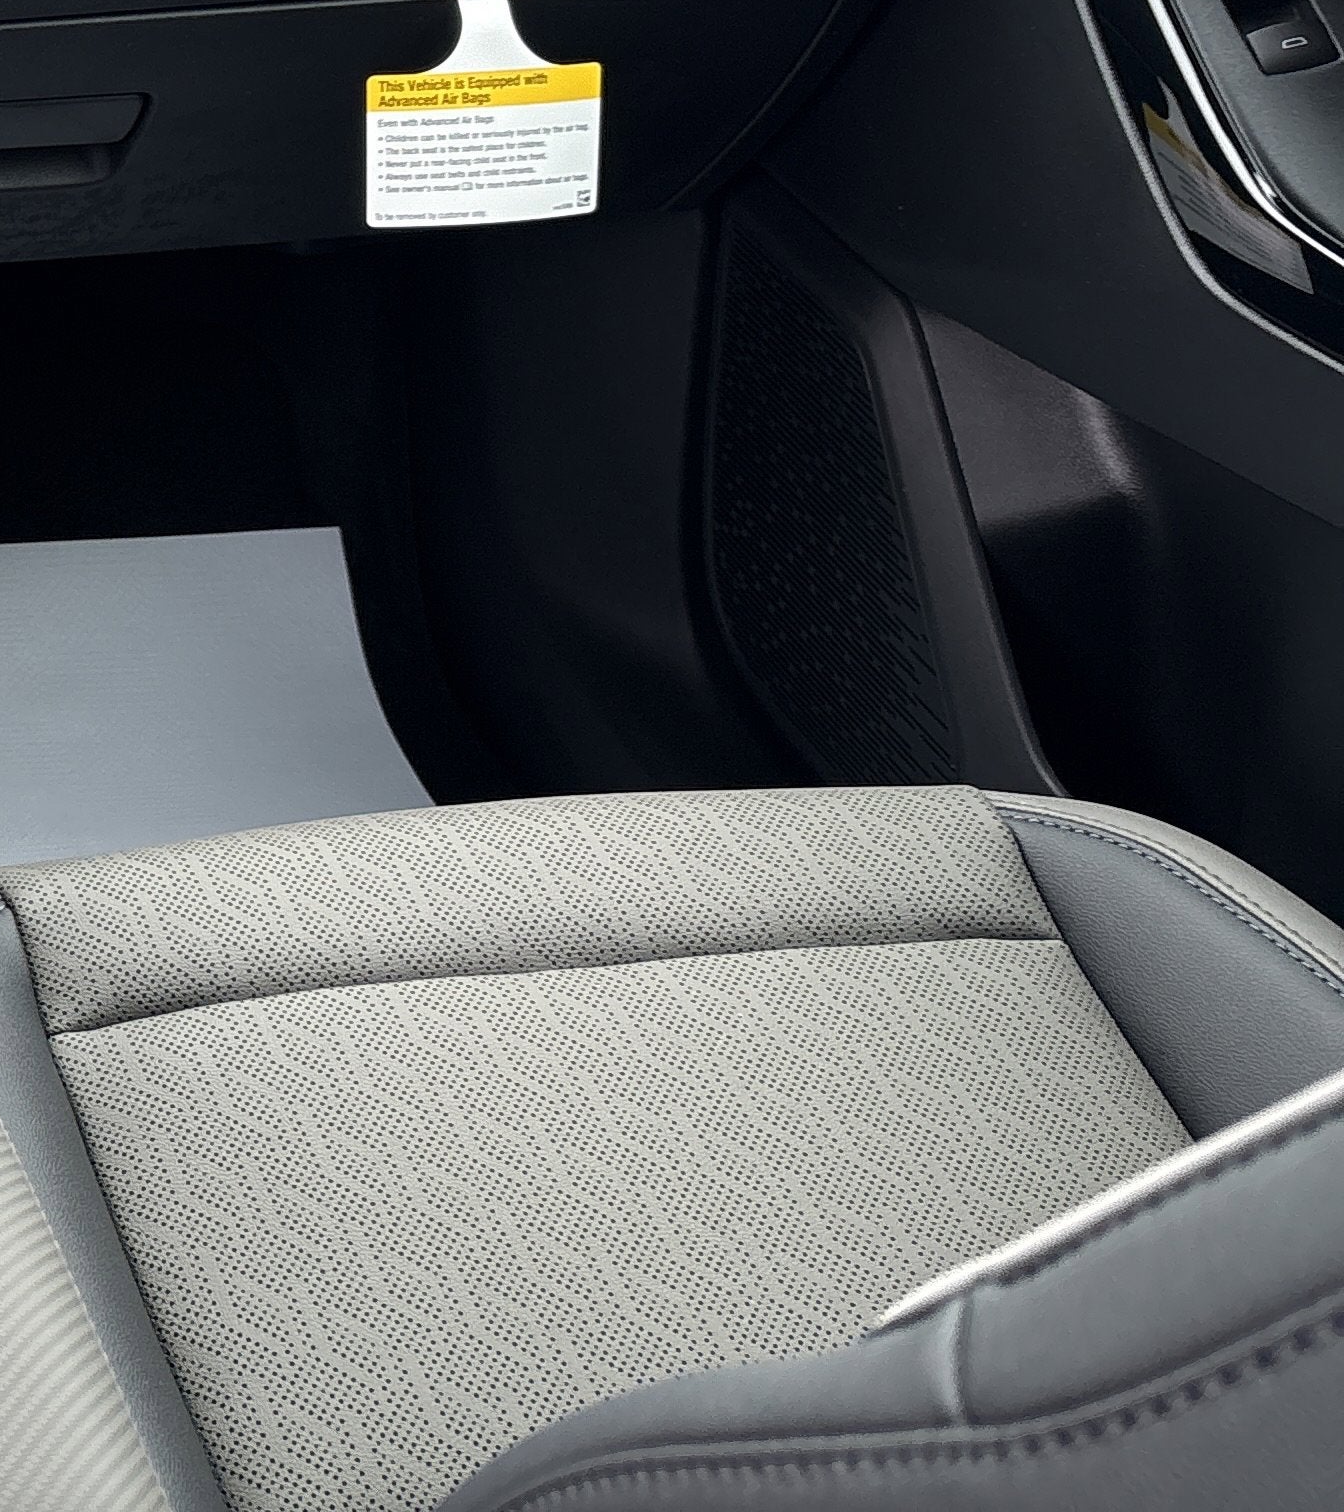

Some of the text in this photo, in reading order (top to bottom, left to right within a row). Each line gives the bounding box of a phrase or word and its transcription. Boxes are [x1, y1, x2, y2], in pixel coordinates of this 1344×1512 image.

[378, 73, 548, 92] This Vehicle is Equipped with
[378, 92, 491, 107] Advanced Air Bags
